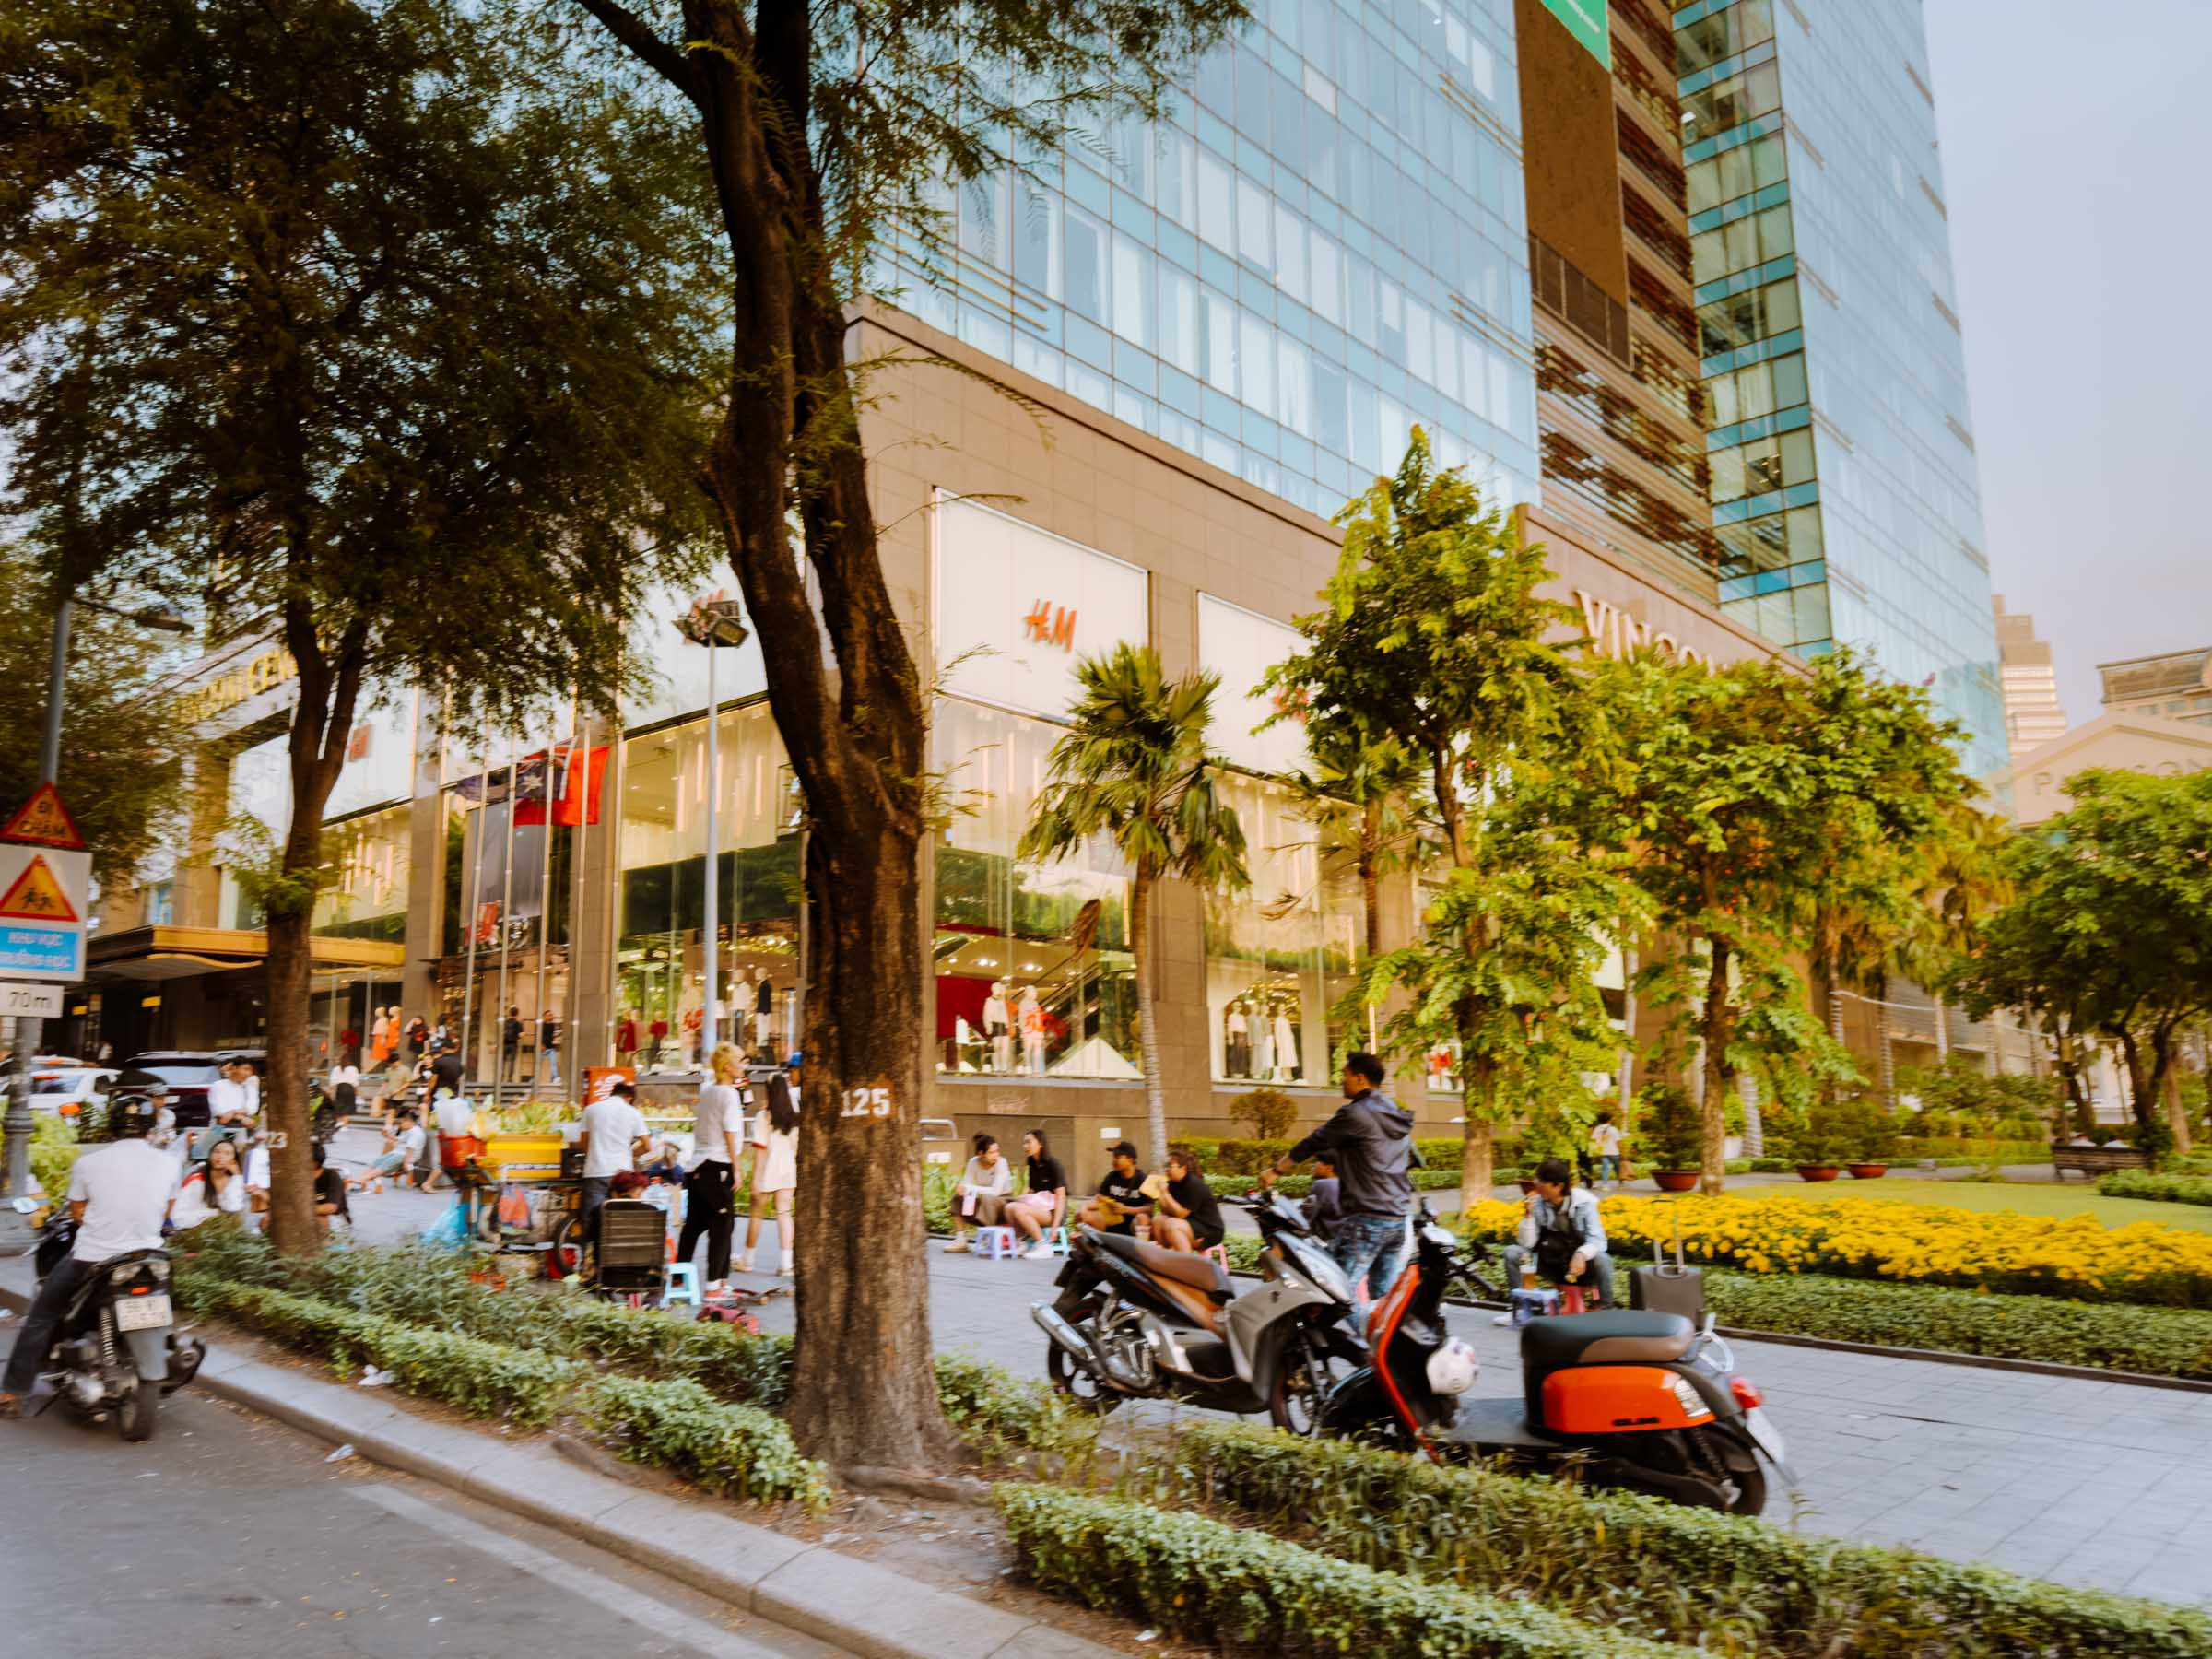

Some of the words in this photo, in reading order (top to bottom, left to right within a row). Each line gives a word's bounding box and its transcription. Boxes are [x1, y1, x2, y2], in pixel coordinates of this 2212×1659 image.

[1023, 597, 1077, 653] H&M
[1572, 589, 1733, 677] VIN
[840, 1088, 891, 1118] 125
